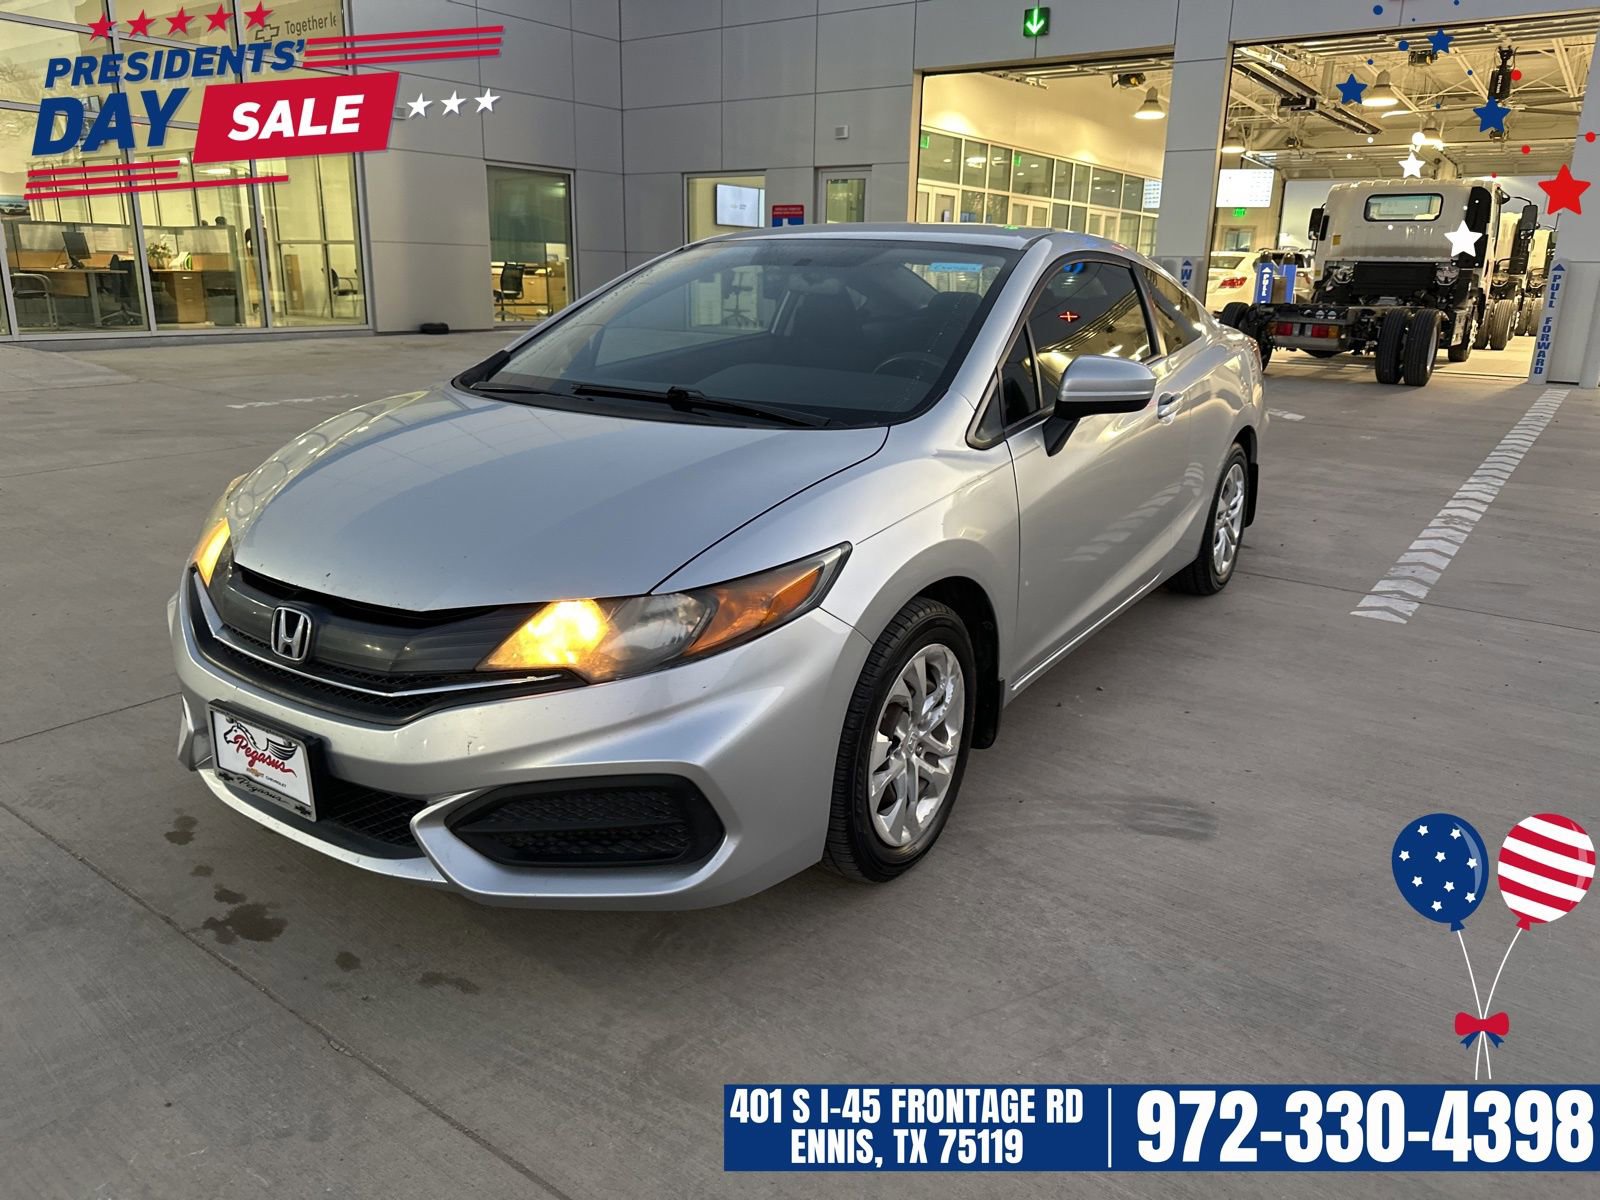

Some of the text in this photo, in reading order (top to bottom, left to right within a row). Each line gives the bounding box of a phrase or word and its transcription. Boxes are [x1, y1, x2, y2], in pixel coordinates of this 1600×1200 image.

[285, 15, 329, 37] Together
[1534, 275, 1561, 374] PULL FORWARD
[234, 734, 298, 778] Pegasus
[237, 776, 289, 804] Pegasus
